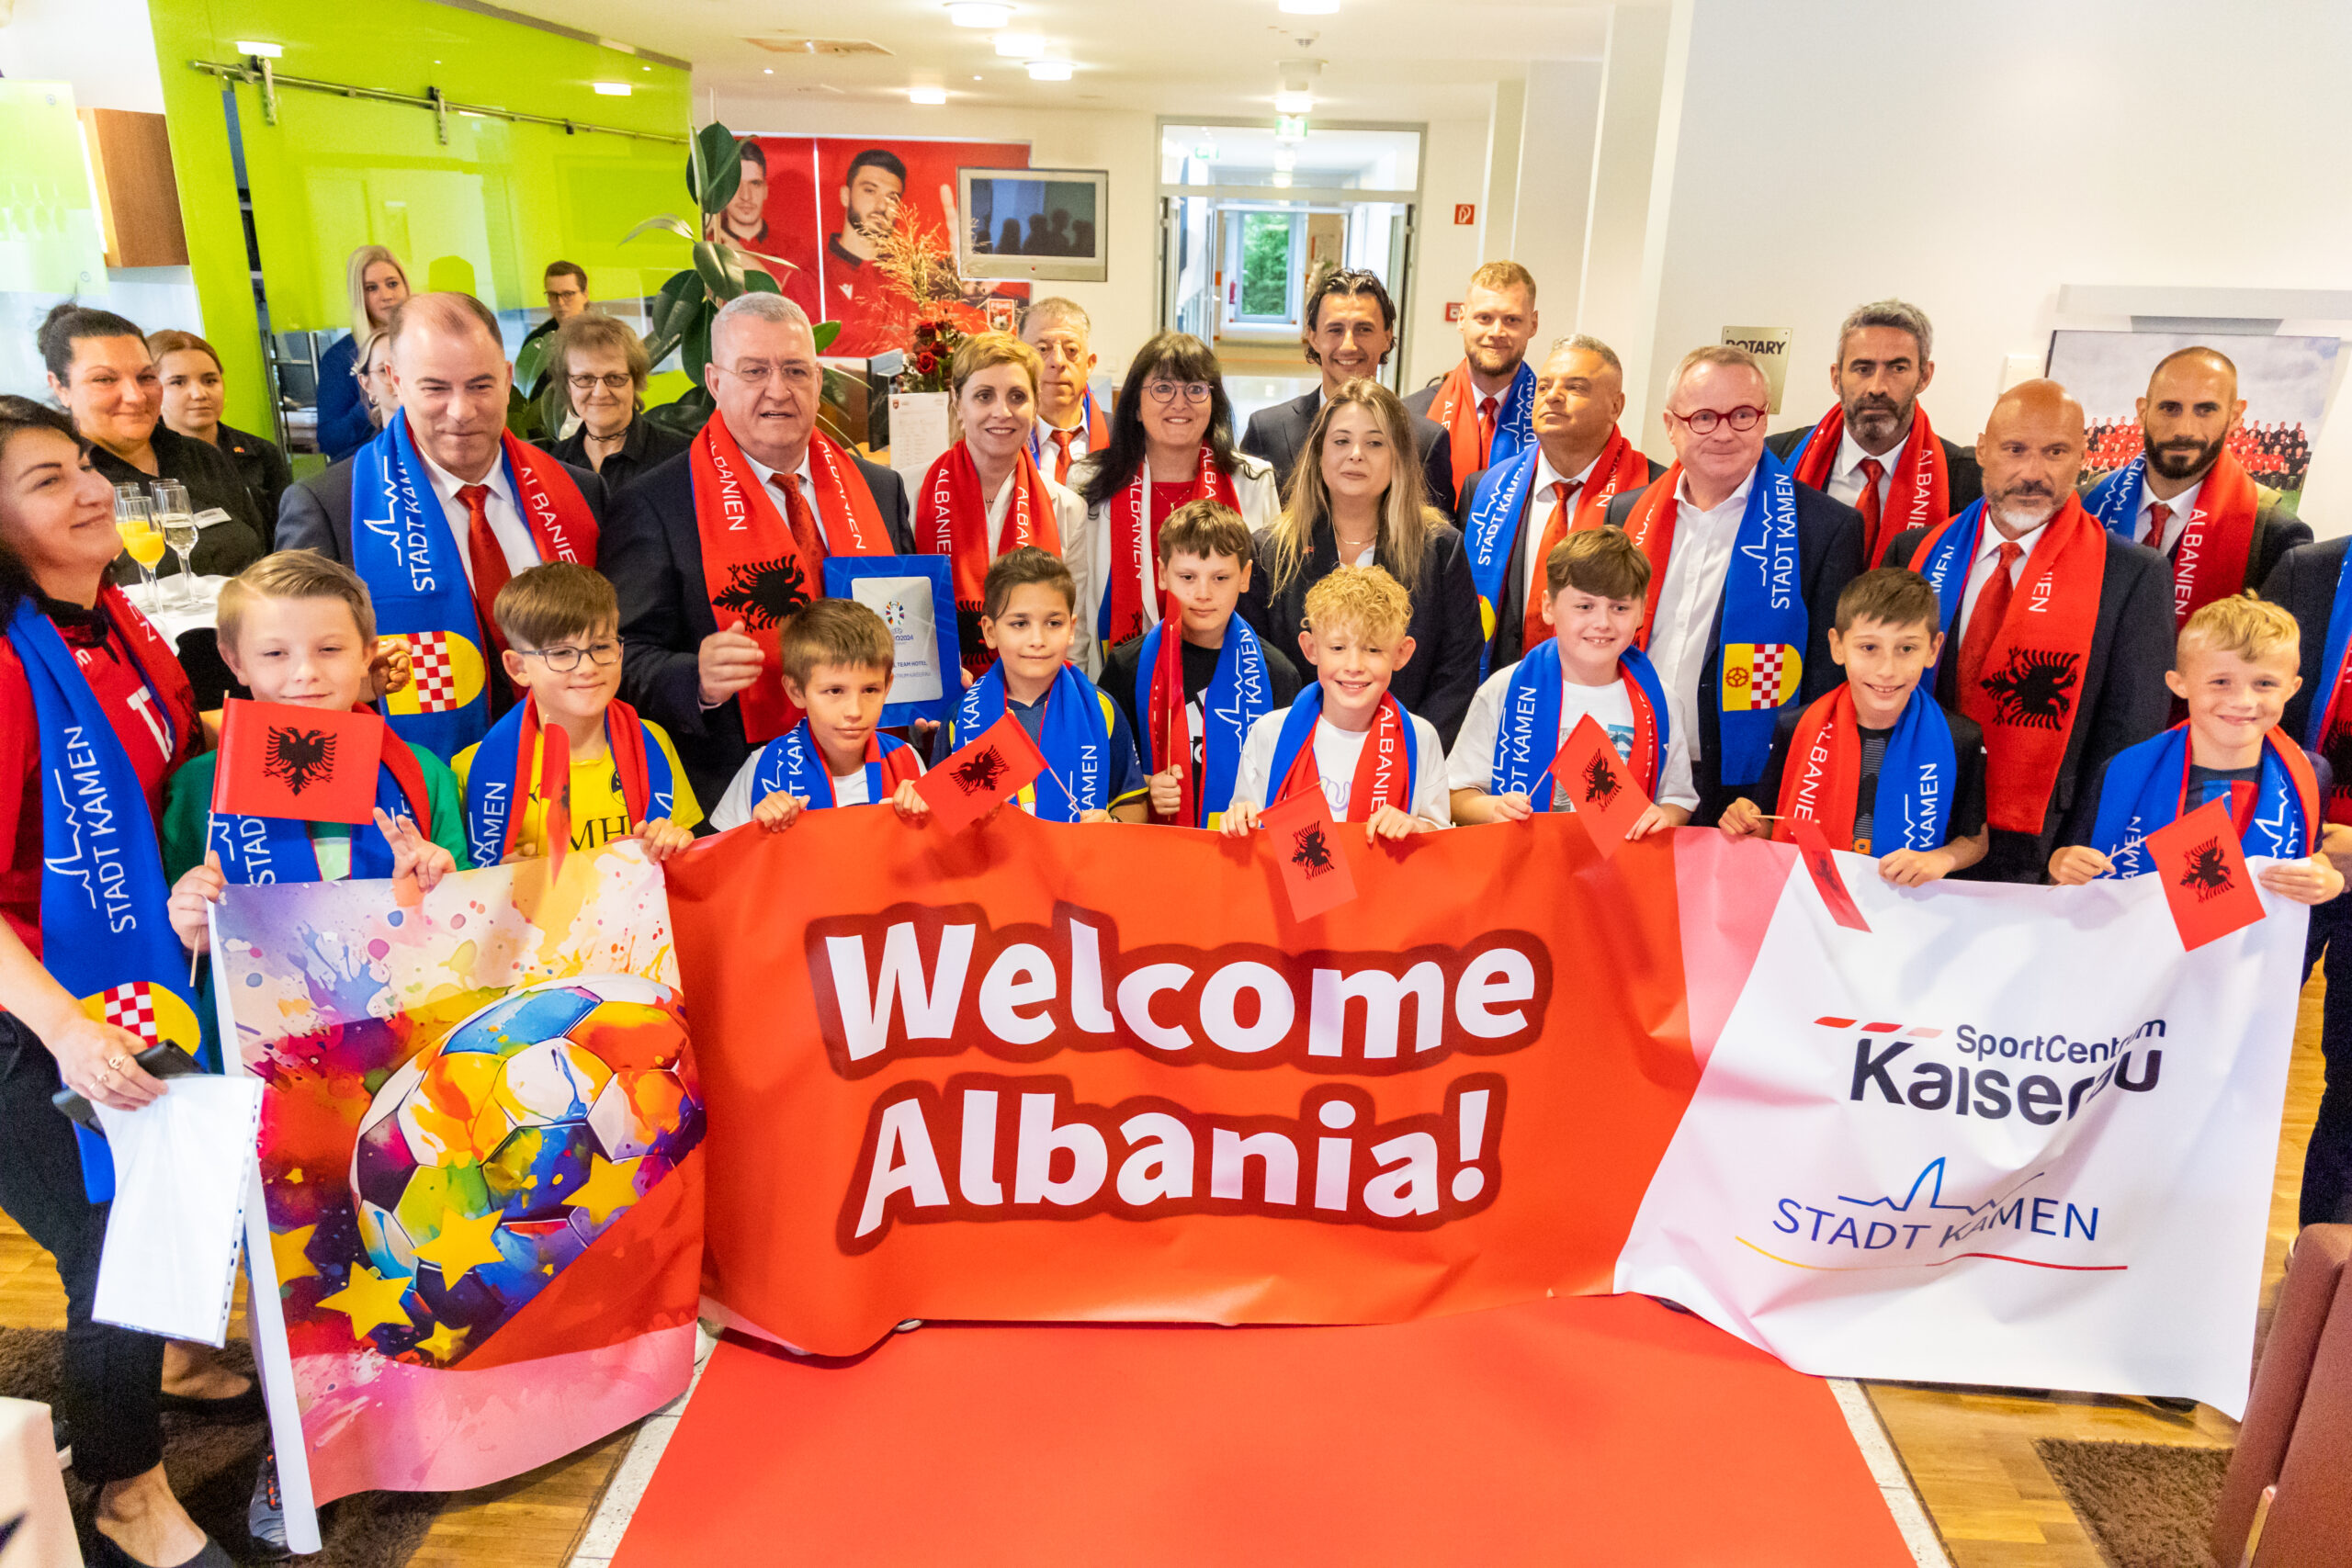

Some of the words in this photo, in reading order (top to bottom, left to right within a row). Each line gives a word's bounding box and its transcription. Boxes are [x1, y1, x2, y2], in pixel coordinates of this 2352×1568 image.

[934, 468, 952, 555] ALBANIE
[1201, 446, 1216, 499] ALBA
[1774, 473, 1796, 538] KAMEN
[1906, 449, 1933, 531] ALBANIE
[406, 515, 435, 592] STADT
[1477, 513, 1503, 566] STADT
[1771, 543, 1794, 610] STADT
[2175, 508, 2208, 615] ALBANIEN
[1239, 629, 1262, 704] KAMEN
[1371, 705, 1394, 813] ALBANIE
[1512, 686, 1537, 763] KAMEN
[63, 726, 117, 837] KAMEN
[1918, 762, 1939, 848] KAMEN
[93, 846, 137, 933] STADT
[237, 814, 277, 887] STAD
[825, 917, 1535, 1062] Welcome
[1956, 1019, 2166, 1064] SportCentrum
[1849, 1038, 2163, 1125] Kaiserau
[854, 1089, 1489, 1238] Albania!
[1772, 1197, 1931, 1250] STADT
[1939, 1197, 2098, 1249] KAMEN
